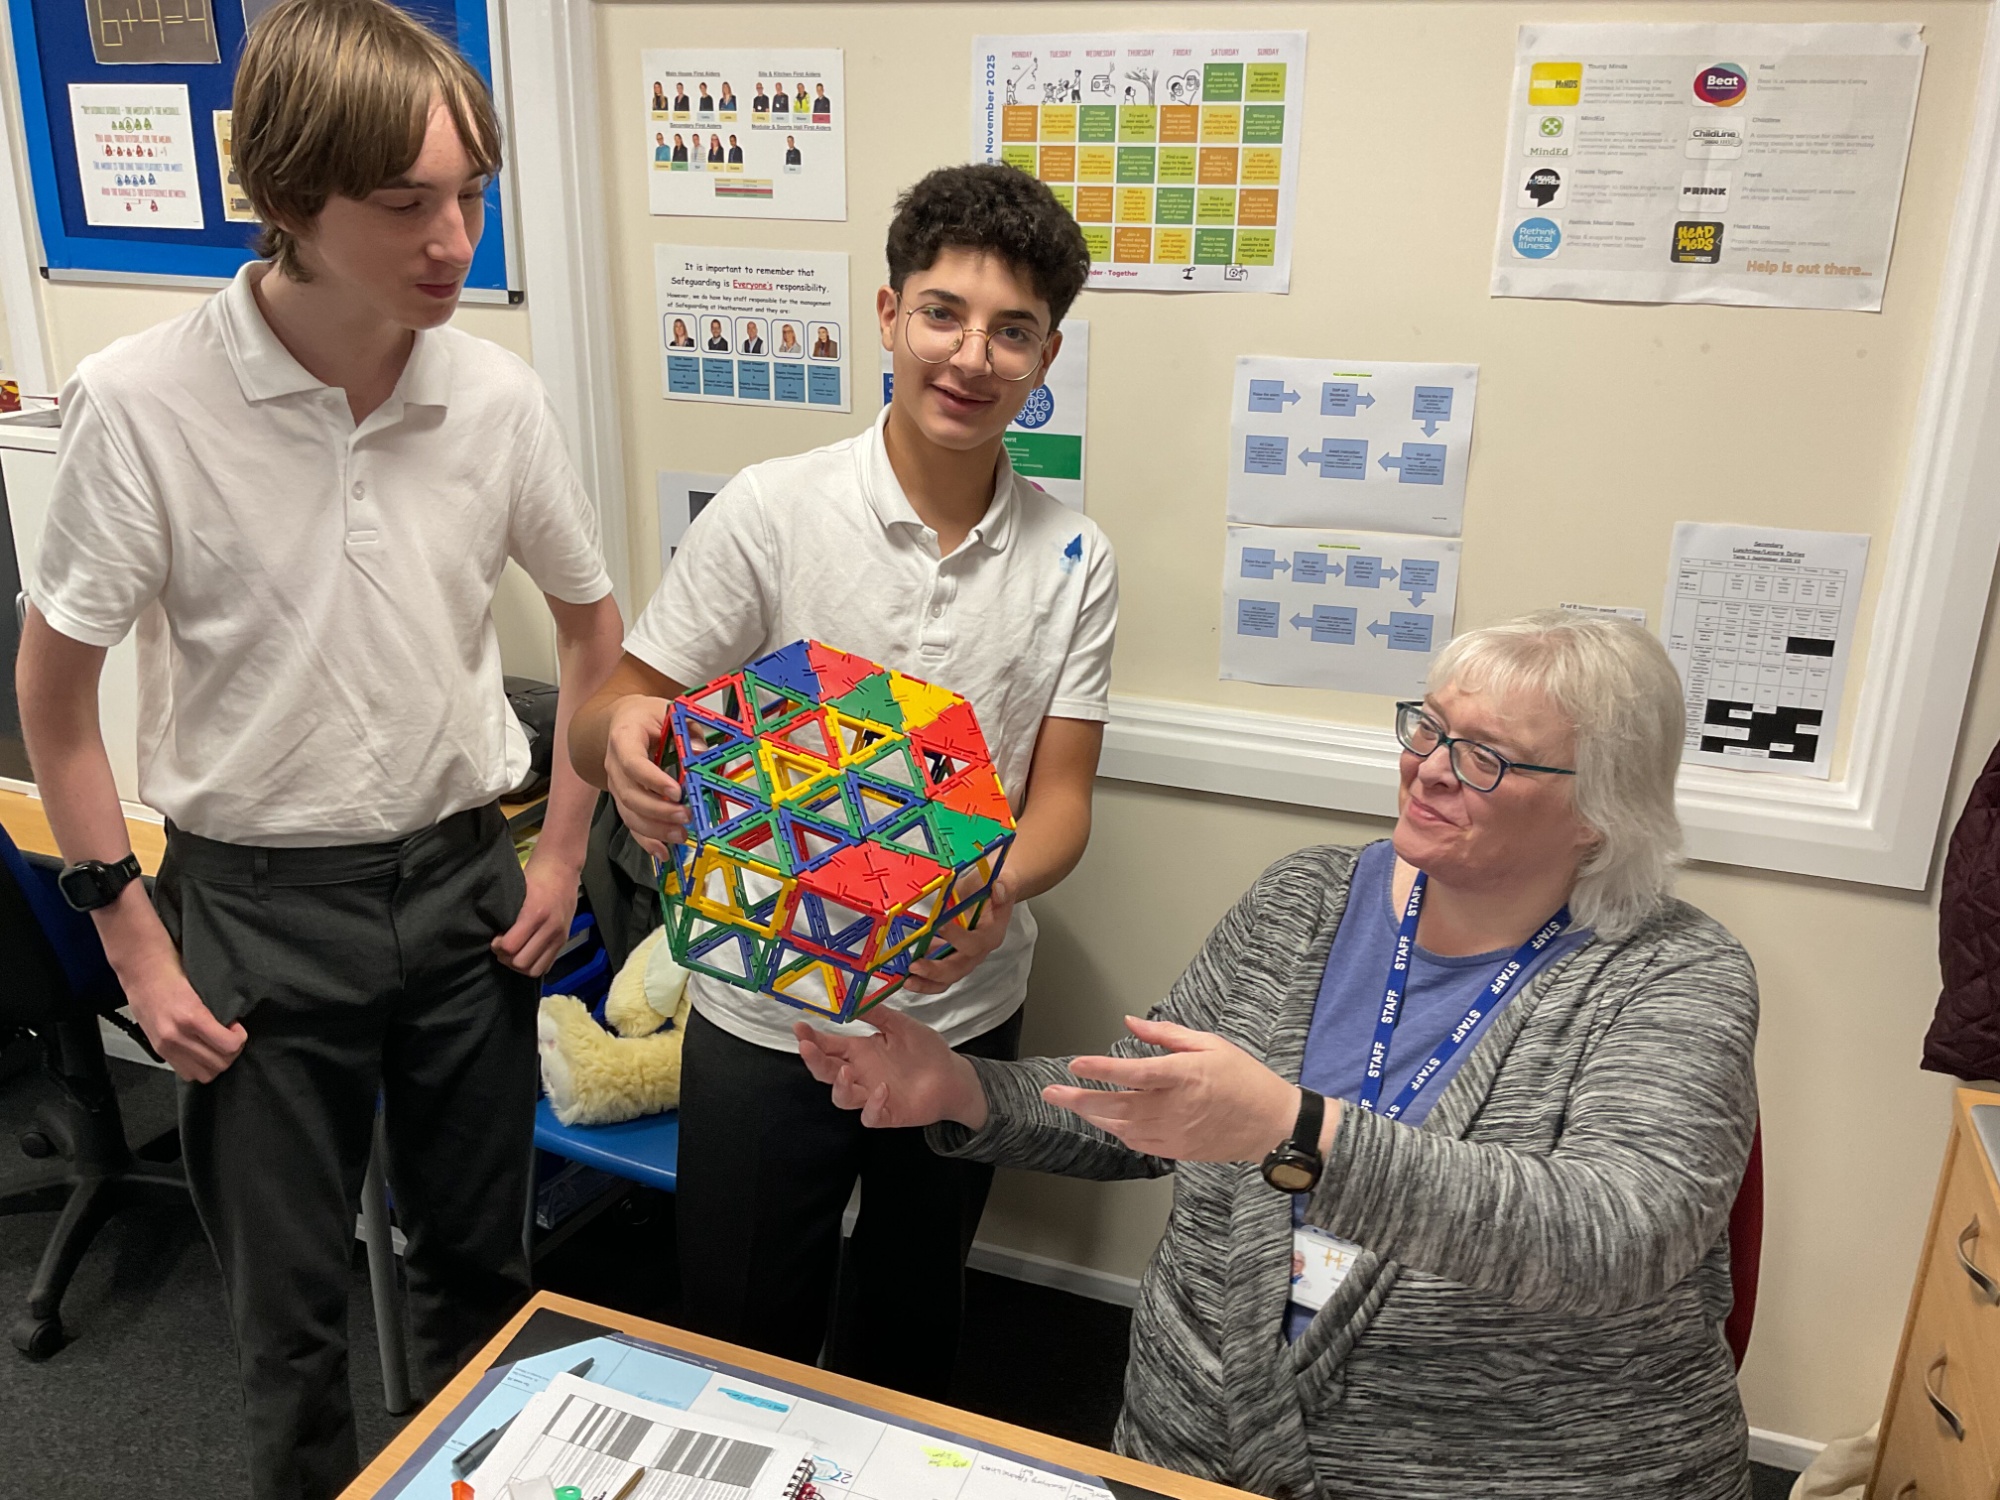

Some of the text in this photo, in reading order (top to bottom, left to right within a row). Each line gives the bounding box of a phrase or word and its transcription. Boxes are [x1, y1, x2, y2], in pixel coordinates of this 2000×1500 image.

[1086, 50, 1116, 58] WEDNESDAY
[1211, 48, 1239, 56] SATURDAY
[1257, 48, 1279, 56] SUNDAY
[1707, 75, 1739, 86] Beat
[985, 54, 995, 153] November 2025
[1692, 130, 1737, 138] ChildLine
[1530, 148, 1569, 156] MindEd
[1683, 186, 1727, 196] FRANK
[1520, 227, 1556, 235] Rethink
[1519, 235, 1552, 243] Mental
[1518, 242, 1552, 250] Illness.
[685, 263, 693, 271] It
[706, 264, 741, 273] important
[756, 268, 794, 276] remember
[798, 269, 814, 277] that
[1746, 260, 1778, 275] Help
[1782, 262, 1794, 273] is
[1797, 264, 1820, 274] out
[671, 277, 829, 293] Safeguarding is Everyone's responsibility.
[675, 302, 708, 310] Safeguarding
[1531, 921, 1560, 950] STAFF
[1368, 885, 1422, 1078] STAFF STAFF STAFF STAFF
[1490, 961, 1520, 994] STAFF
[1452, 1010, 1481, 1043] STAFF
[1411, 1058, 1440, 1090] STAFF
